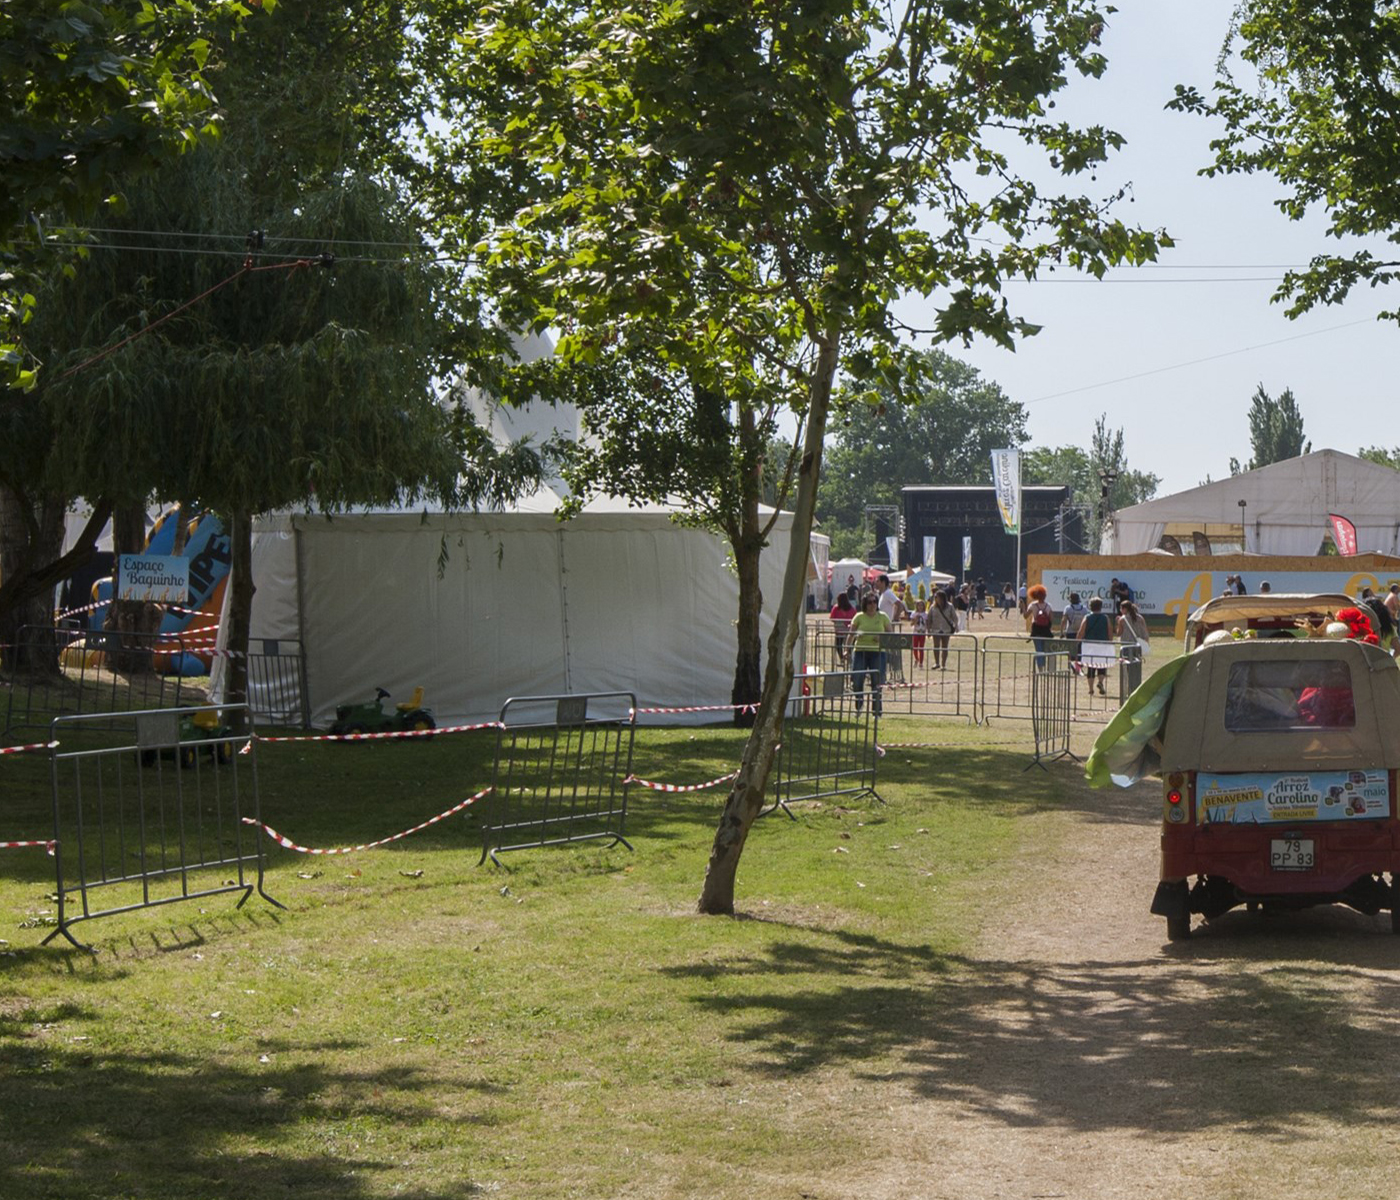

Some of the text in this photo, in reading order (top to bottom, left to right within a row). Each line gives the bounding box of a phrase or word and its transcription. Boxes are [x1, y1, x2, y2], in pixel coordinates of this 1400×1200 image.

[123, 557, 165, 574] Espaço
[1273, 781, 1309, 794] Arroz
[1364, 787, 1387, 797] maio
[1204, 790, 1260, 807] BENAVENTE
[1267, 792, 1318, 805] Carolino
[1284, 840, 1301, 853] 79
